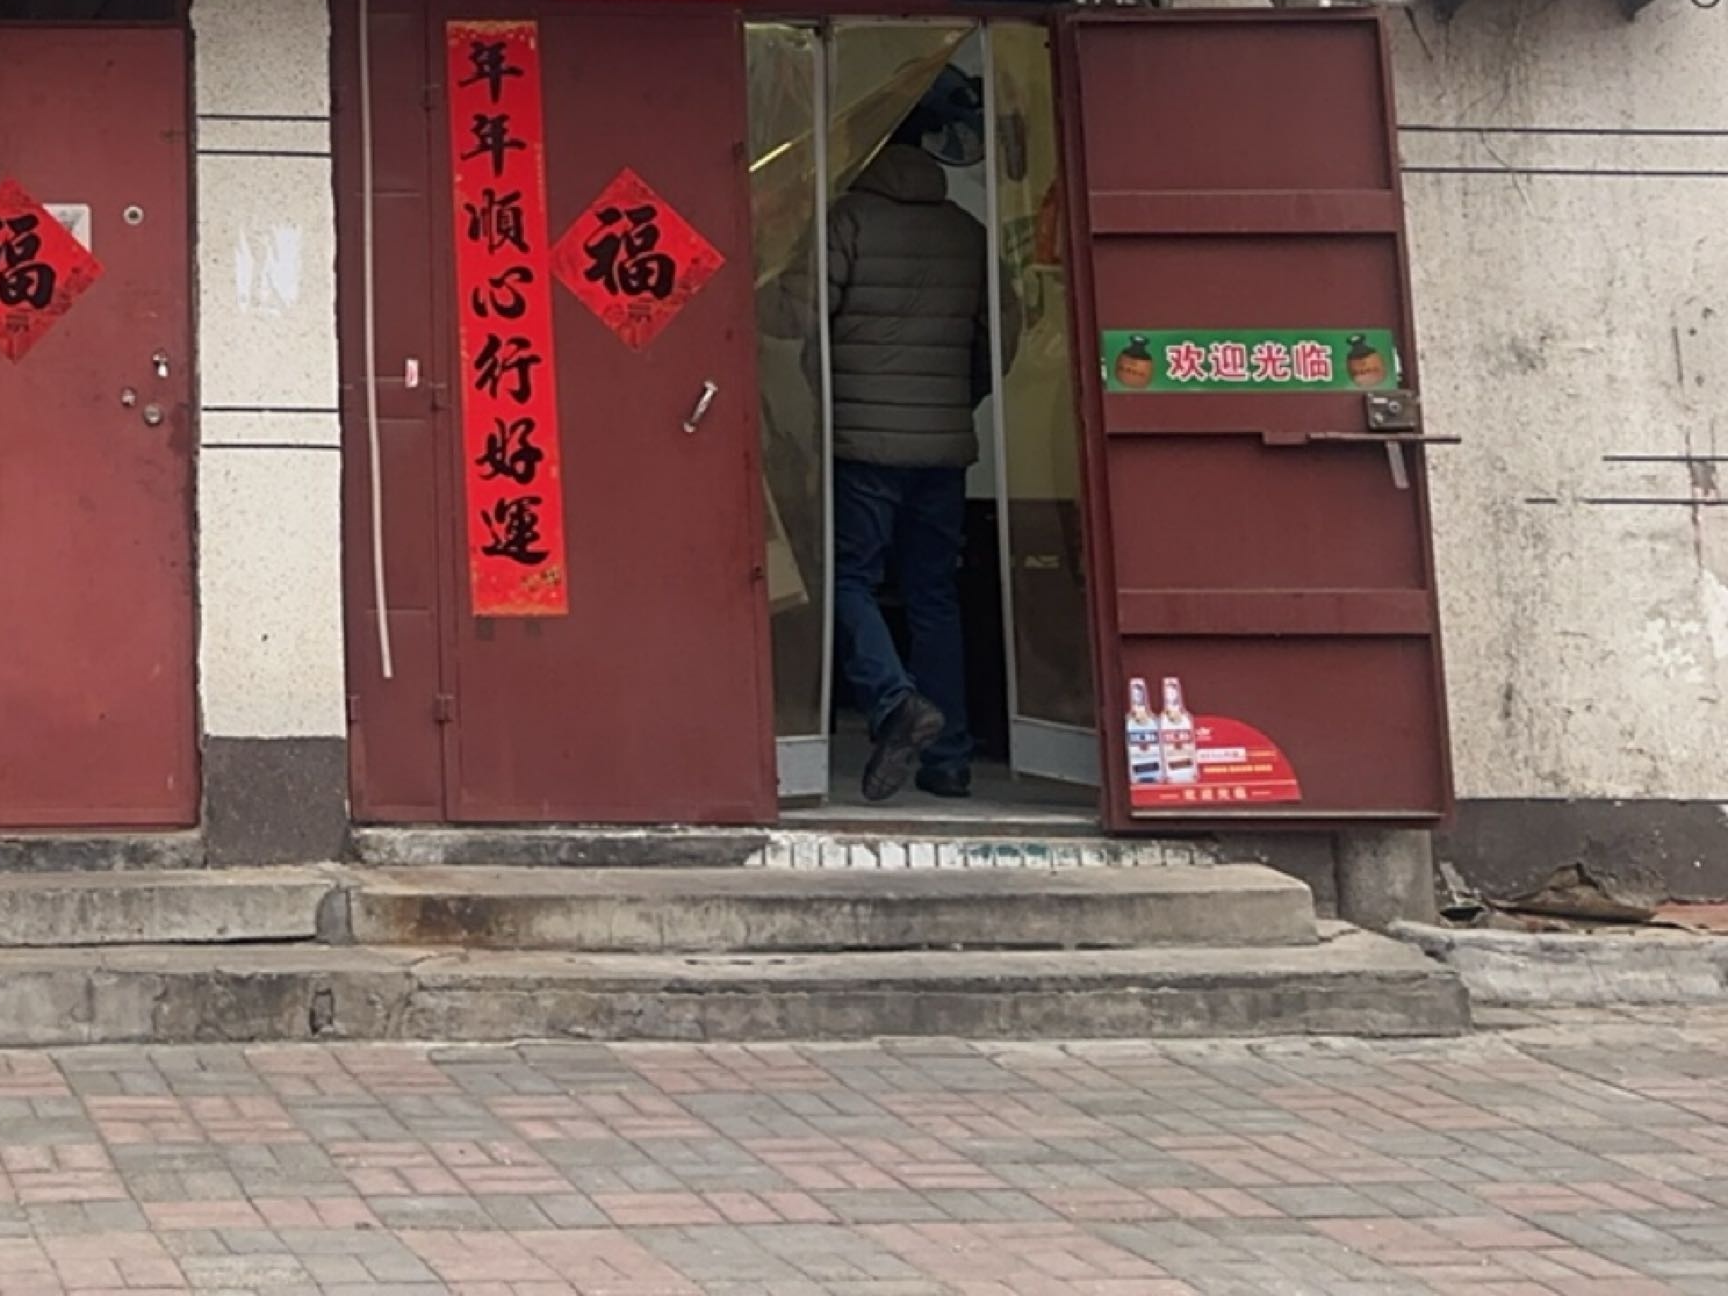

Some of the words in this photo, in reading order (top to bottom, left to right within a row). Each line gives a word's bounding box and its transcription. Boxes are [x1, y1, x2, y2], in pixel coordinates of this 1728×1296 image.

[583, 204, 677, 300] 福
[1166, 340, 1333, 383] 欢迎光临
